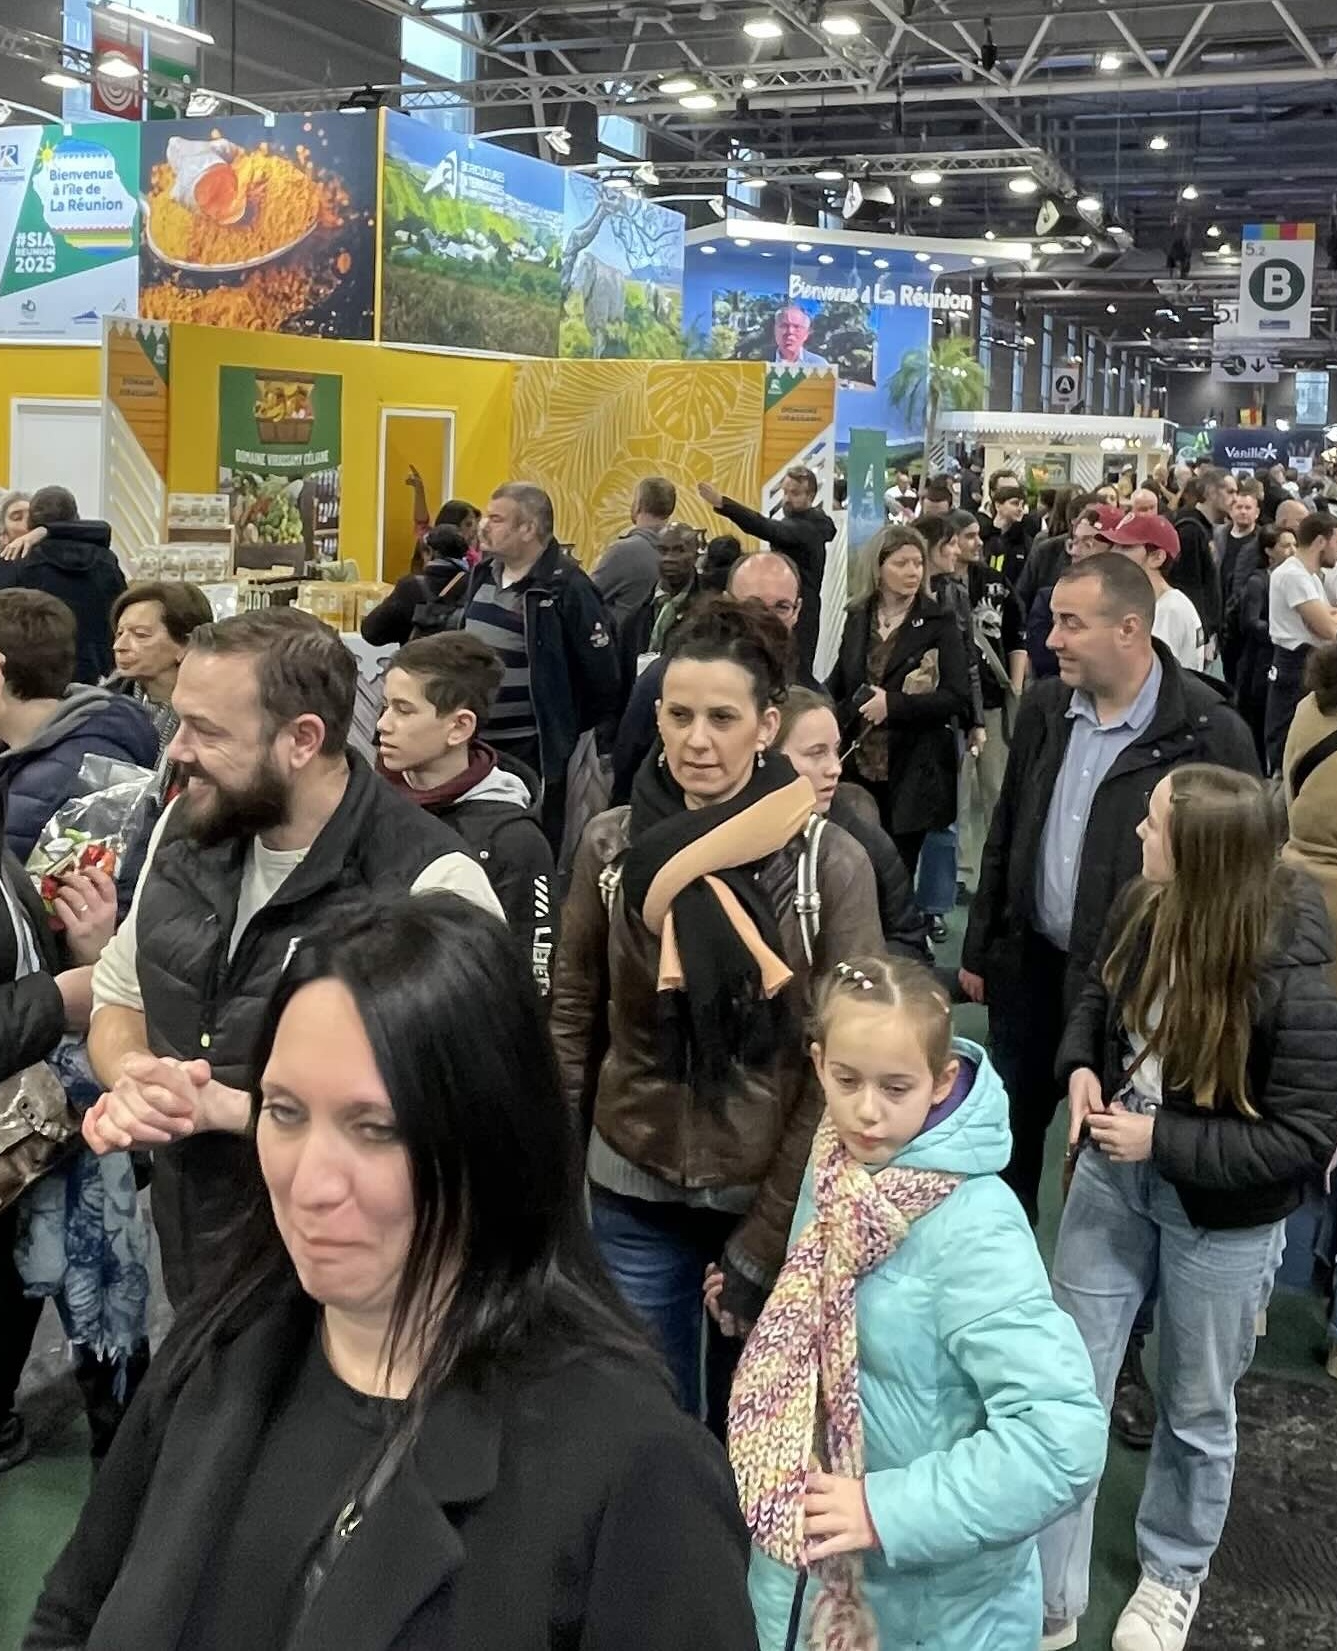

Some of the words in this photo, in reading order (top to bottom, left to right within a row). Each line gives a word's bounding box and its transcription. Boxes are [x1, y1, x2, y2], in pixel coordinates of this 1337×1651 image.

[49, 169, 114, 181] Bienvenue
[53, 184, 60, 195] à
[85, 184, 101, 195] de
[50, 200, 65, 212] La
[68, 199, 123, 211] Réunion
[16, 231, 55, 247] #SIA
[1245, 242, 1266, 257] 5.2
[15, 257, 56, 273] 2025
[789, 274, 859, 302] Bienvenue
[874, 284, 895, 305] La
[901, 285, 972, 310] Réunion
[1263, 267, 1292, 303] B
